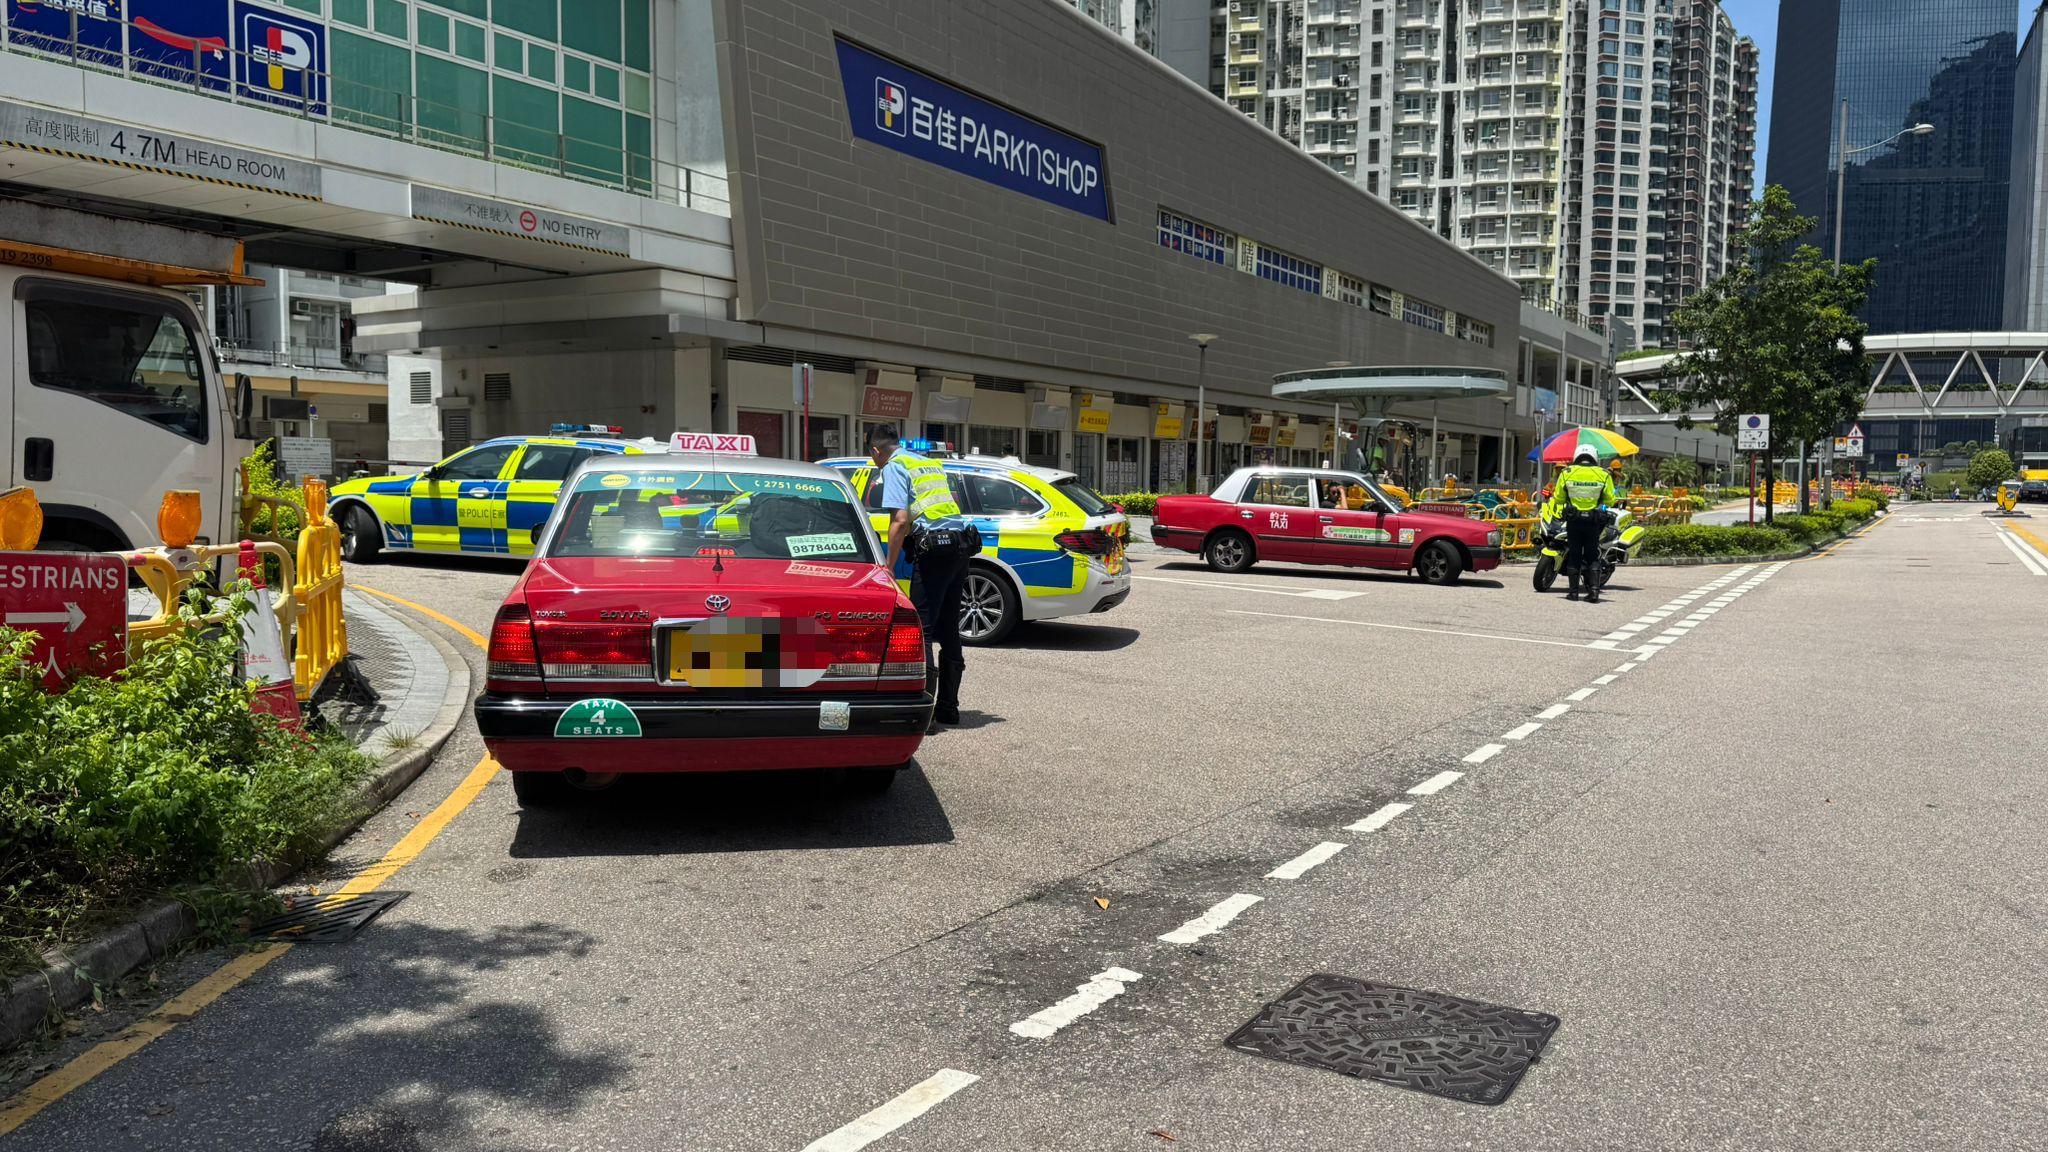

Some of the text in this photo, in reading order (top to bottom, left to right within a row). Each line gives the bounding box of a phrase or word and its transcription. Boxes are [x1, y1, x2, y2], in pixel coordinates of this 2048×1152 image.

[25, 116, 100, 147] 高度限制
[911, 96, 957, 151] 百佳
[110, 130, 177, 165] 4.7M
[185, 149, 286, 181] HEAD ROOM
[464, 203, 514, 225] 不准駛入
[542, 218, 602, 241] NO ENTRY
[677, 434, 750, 451] TAXI
[764, 480, 822, 493] 2751 6666
[1420, 504, 1465, 513] PEDESTRIANS
[1269, 519, 1288, 529] TAXI
[793, 543, 853, 554] 98784044
[581, 700, 617, 710] TAXI
[590, 709, 607, 725] 4
[573, 726, 624, 735] SEATS
